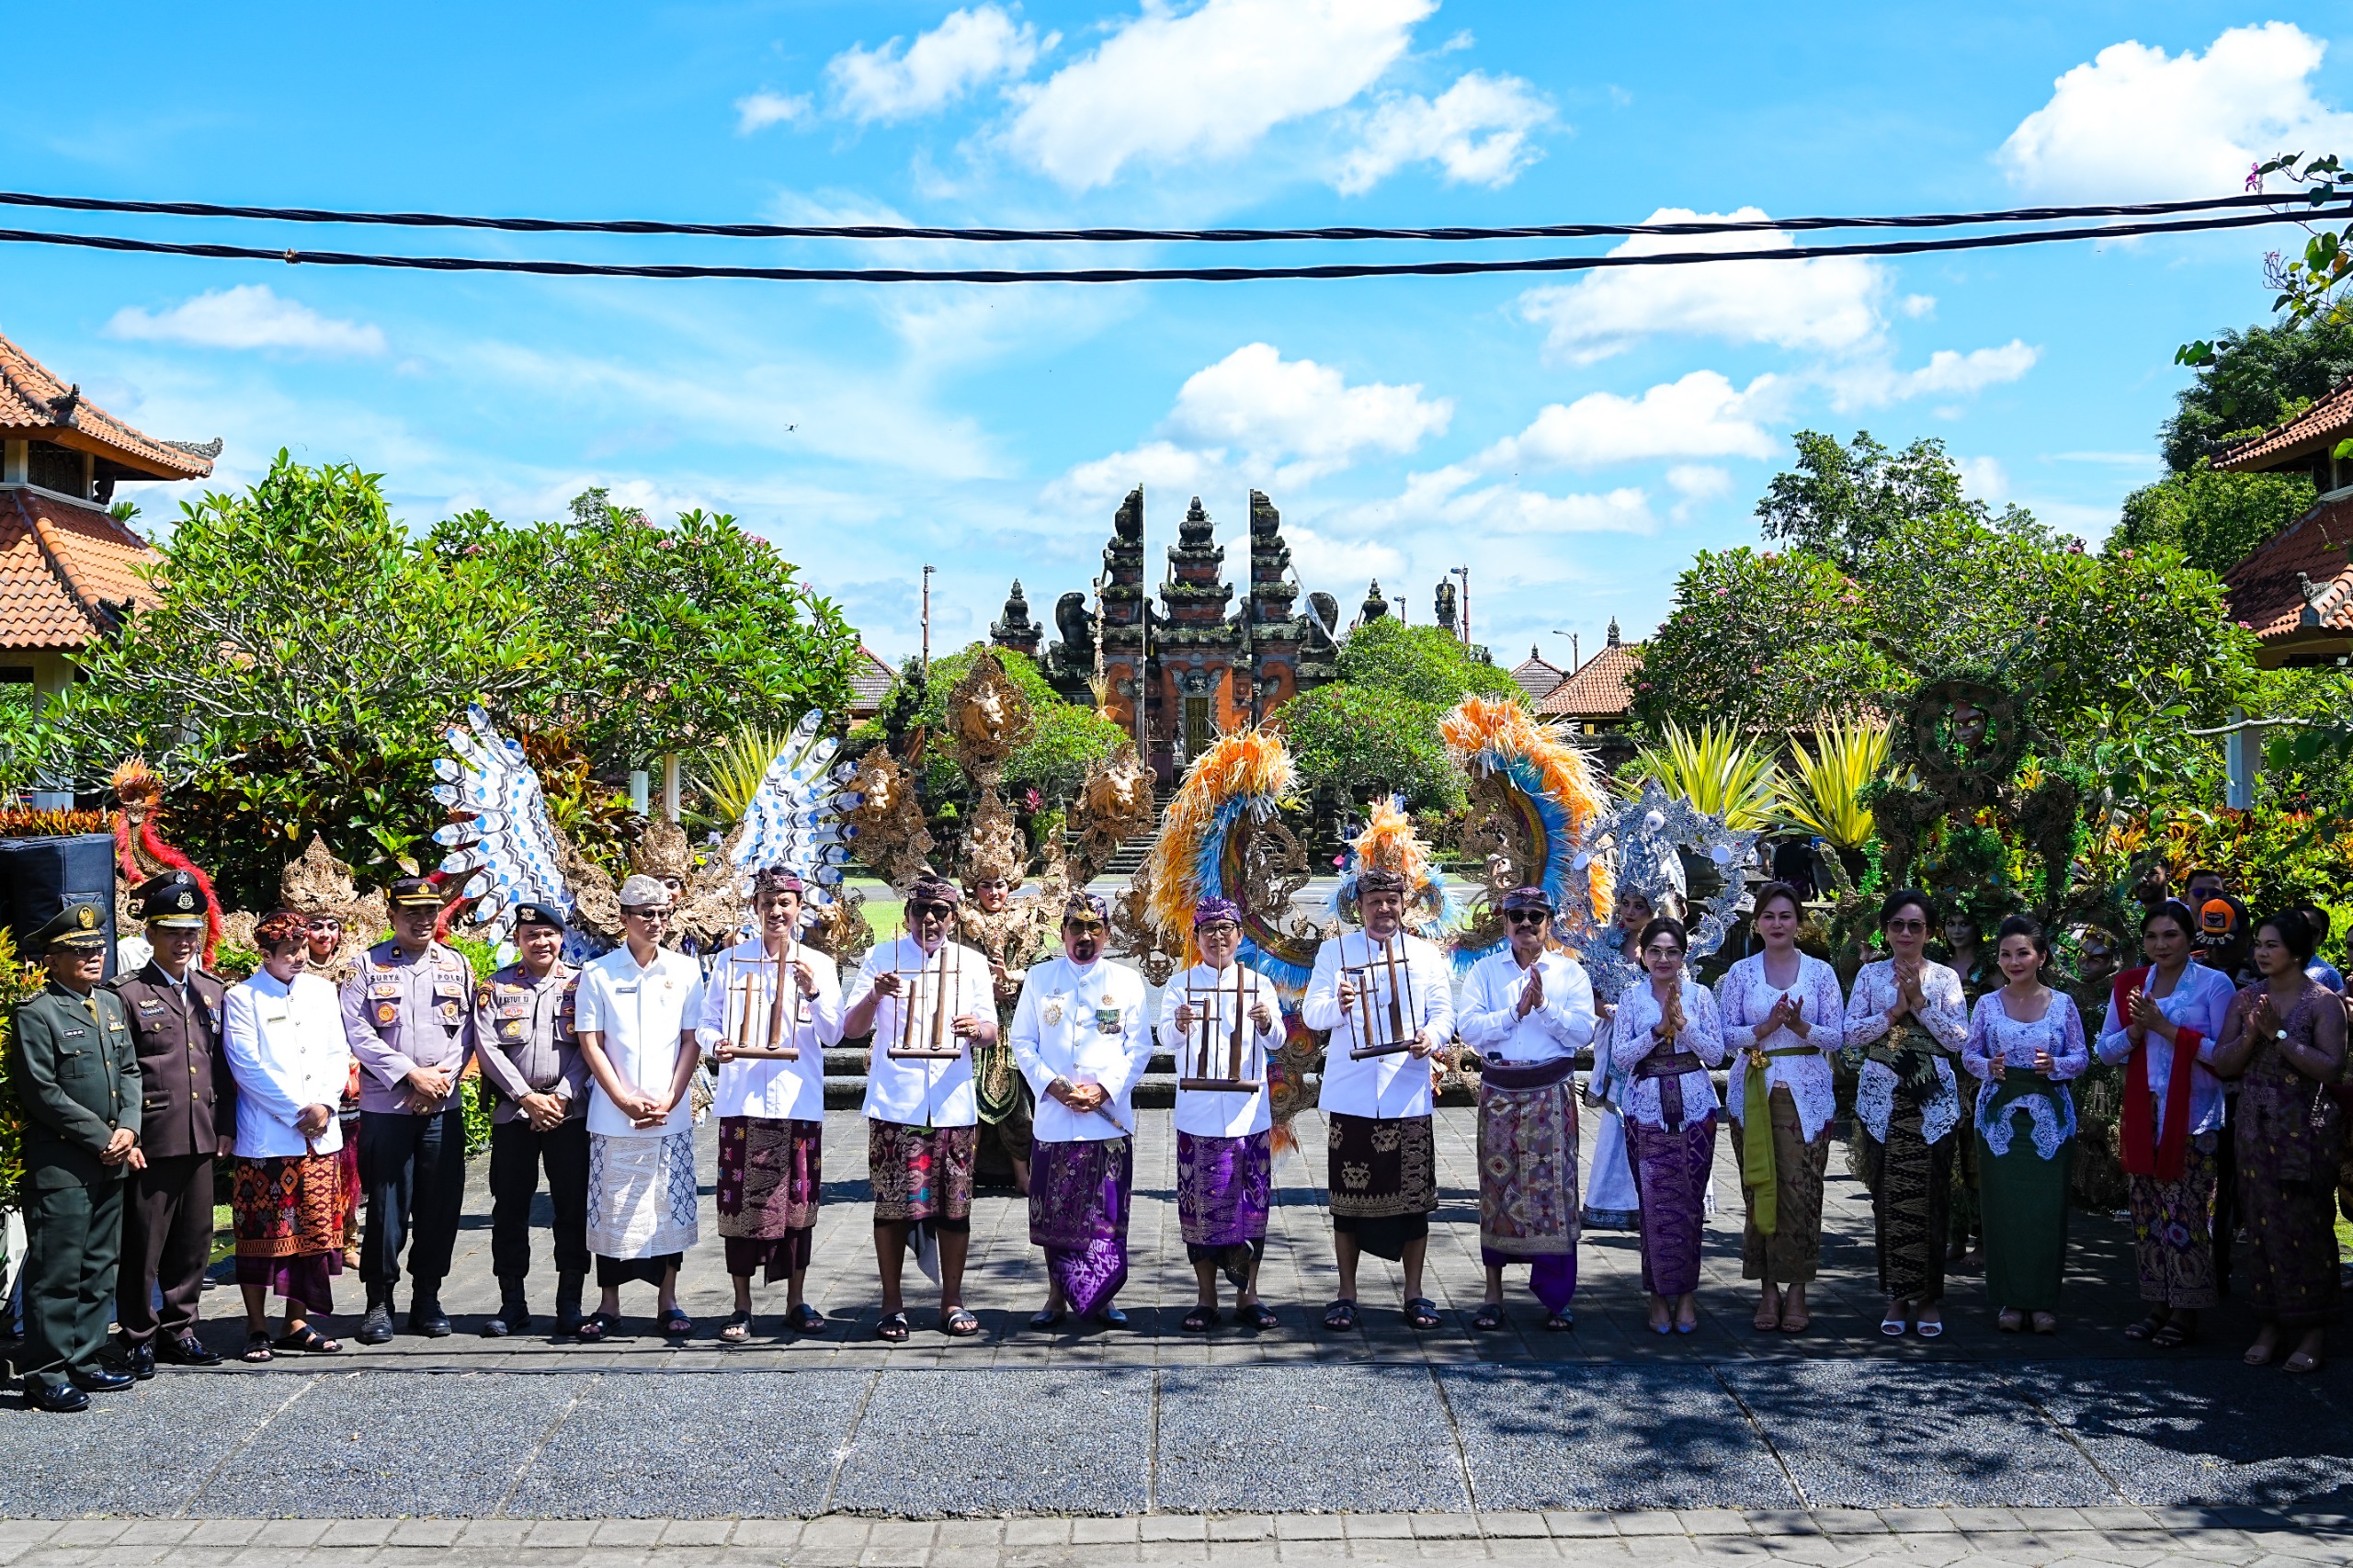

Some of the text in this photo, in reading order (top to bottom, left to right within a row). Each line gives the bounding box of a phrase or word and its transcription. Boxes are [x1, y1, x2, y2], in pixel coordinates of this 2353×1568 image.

[2195, 929, 2235, 945] DISHUB
[369, 974, 400, 983] SURYA
[438, 974, 463, 983] POLRI
[504, 995, 521, 1004] KETUT
[556, 994, 575, 1003] POL
